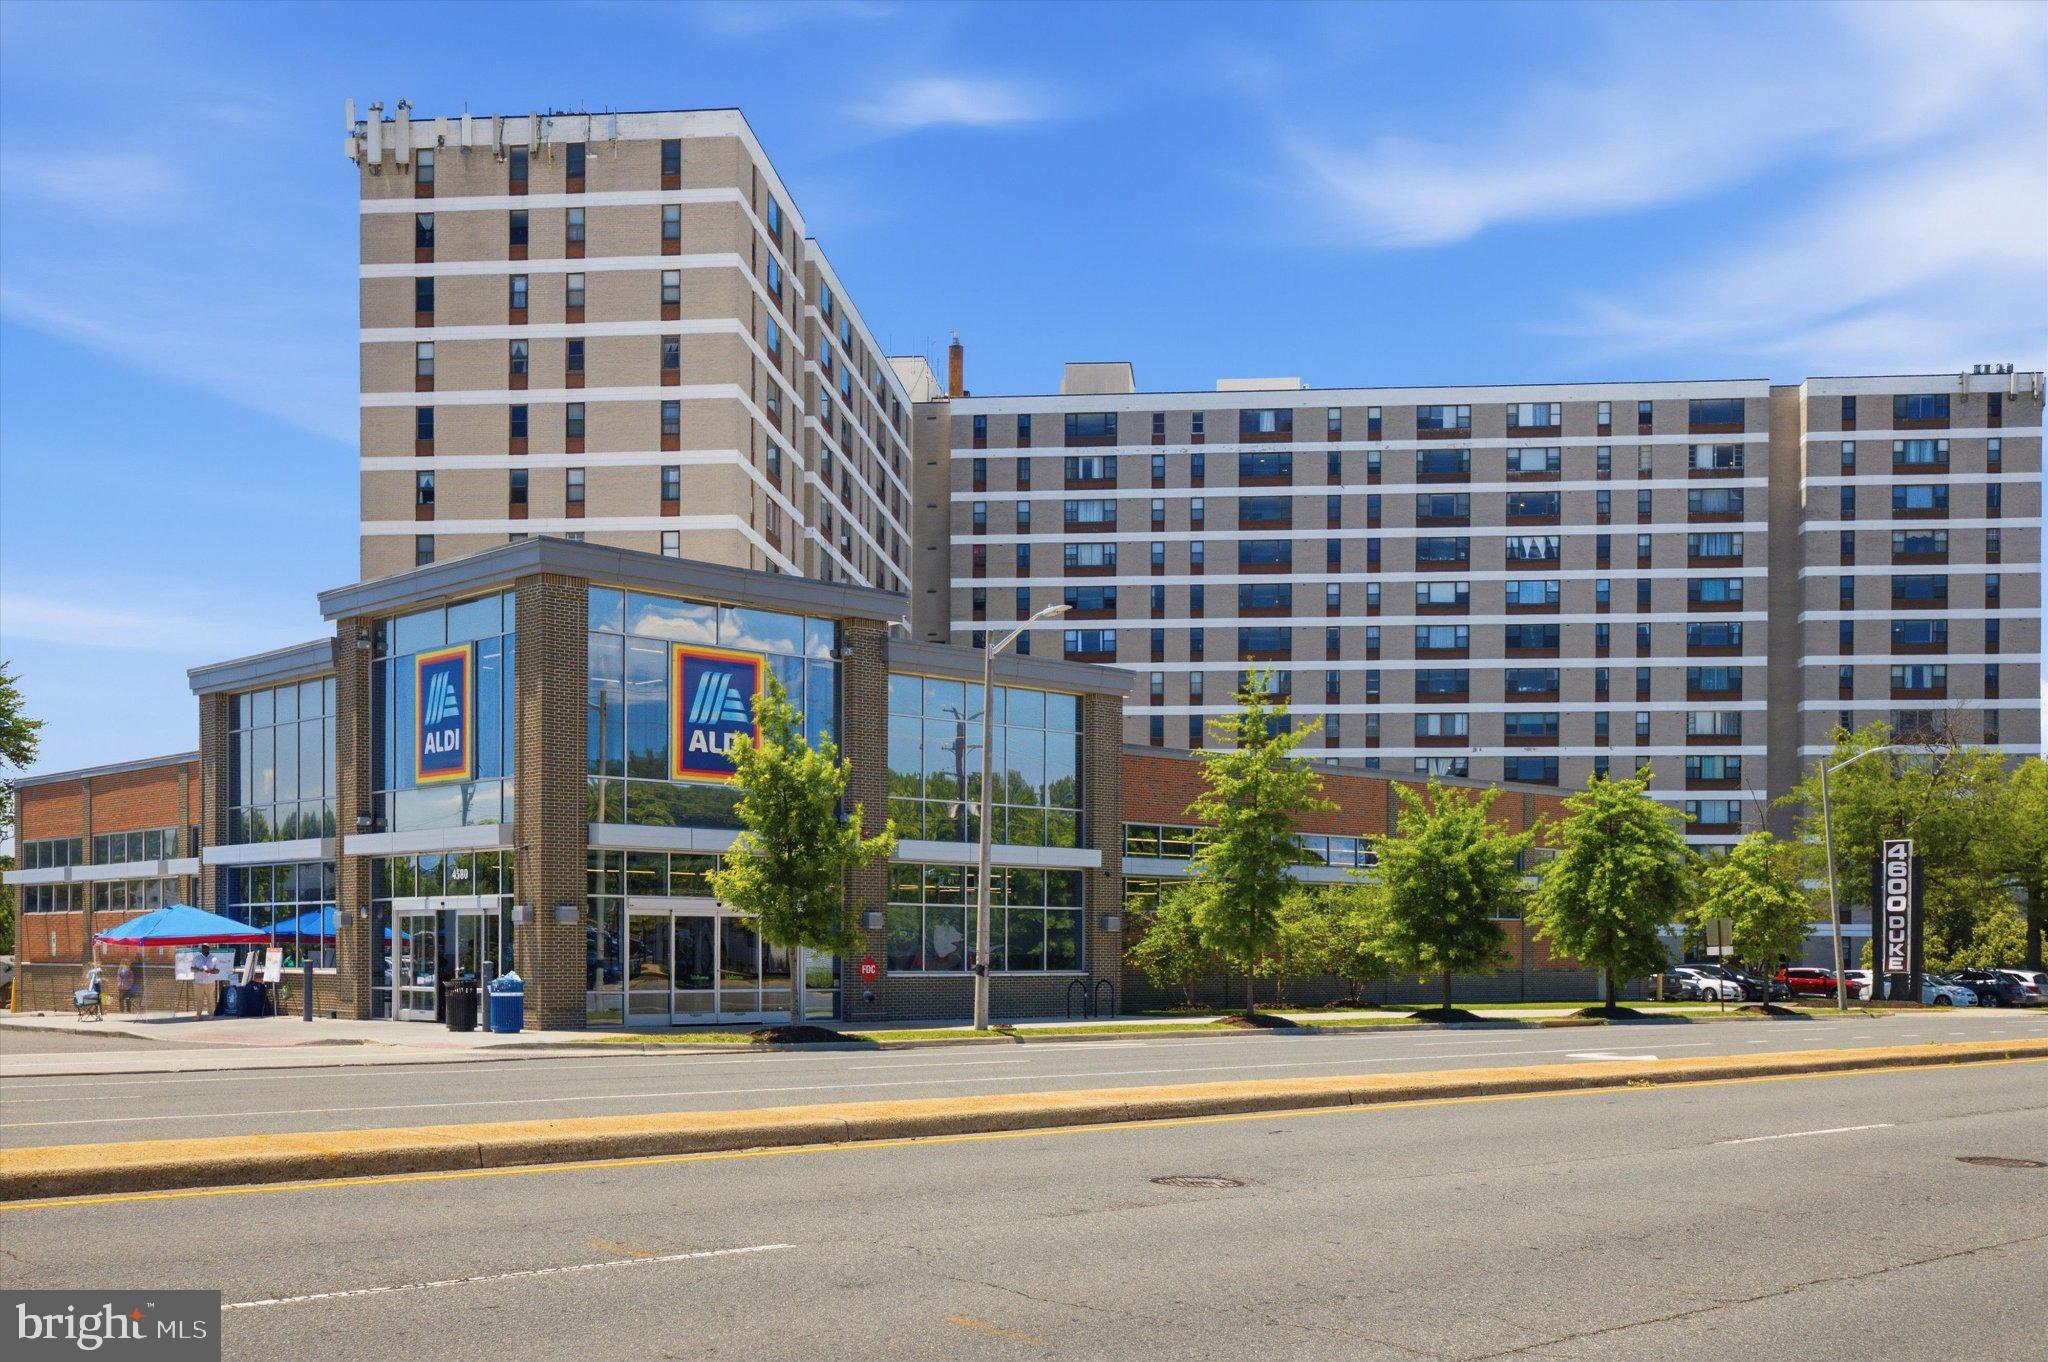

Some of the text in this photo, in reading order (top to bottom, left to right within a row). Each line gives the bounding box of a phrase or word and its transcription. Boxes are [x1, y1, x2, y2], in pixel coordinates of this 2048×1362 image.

[424, 728, 460, 754] ALDI
[688, 729, 742, 754] ALD
[1887, 843, 1907, 970] 4600 DUKE
[861, 964, 876, 974] FDC
